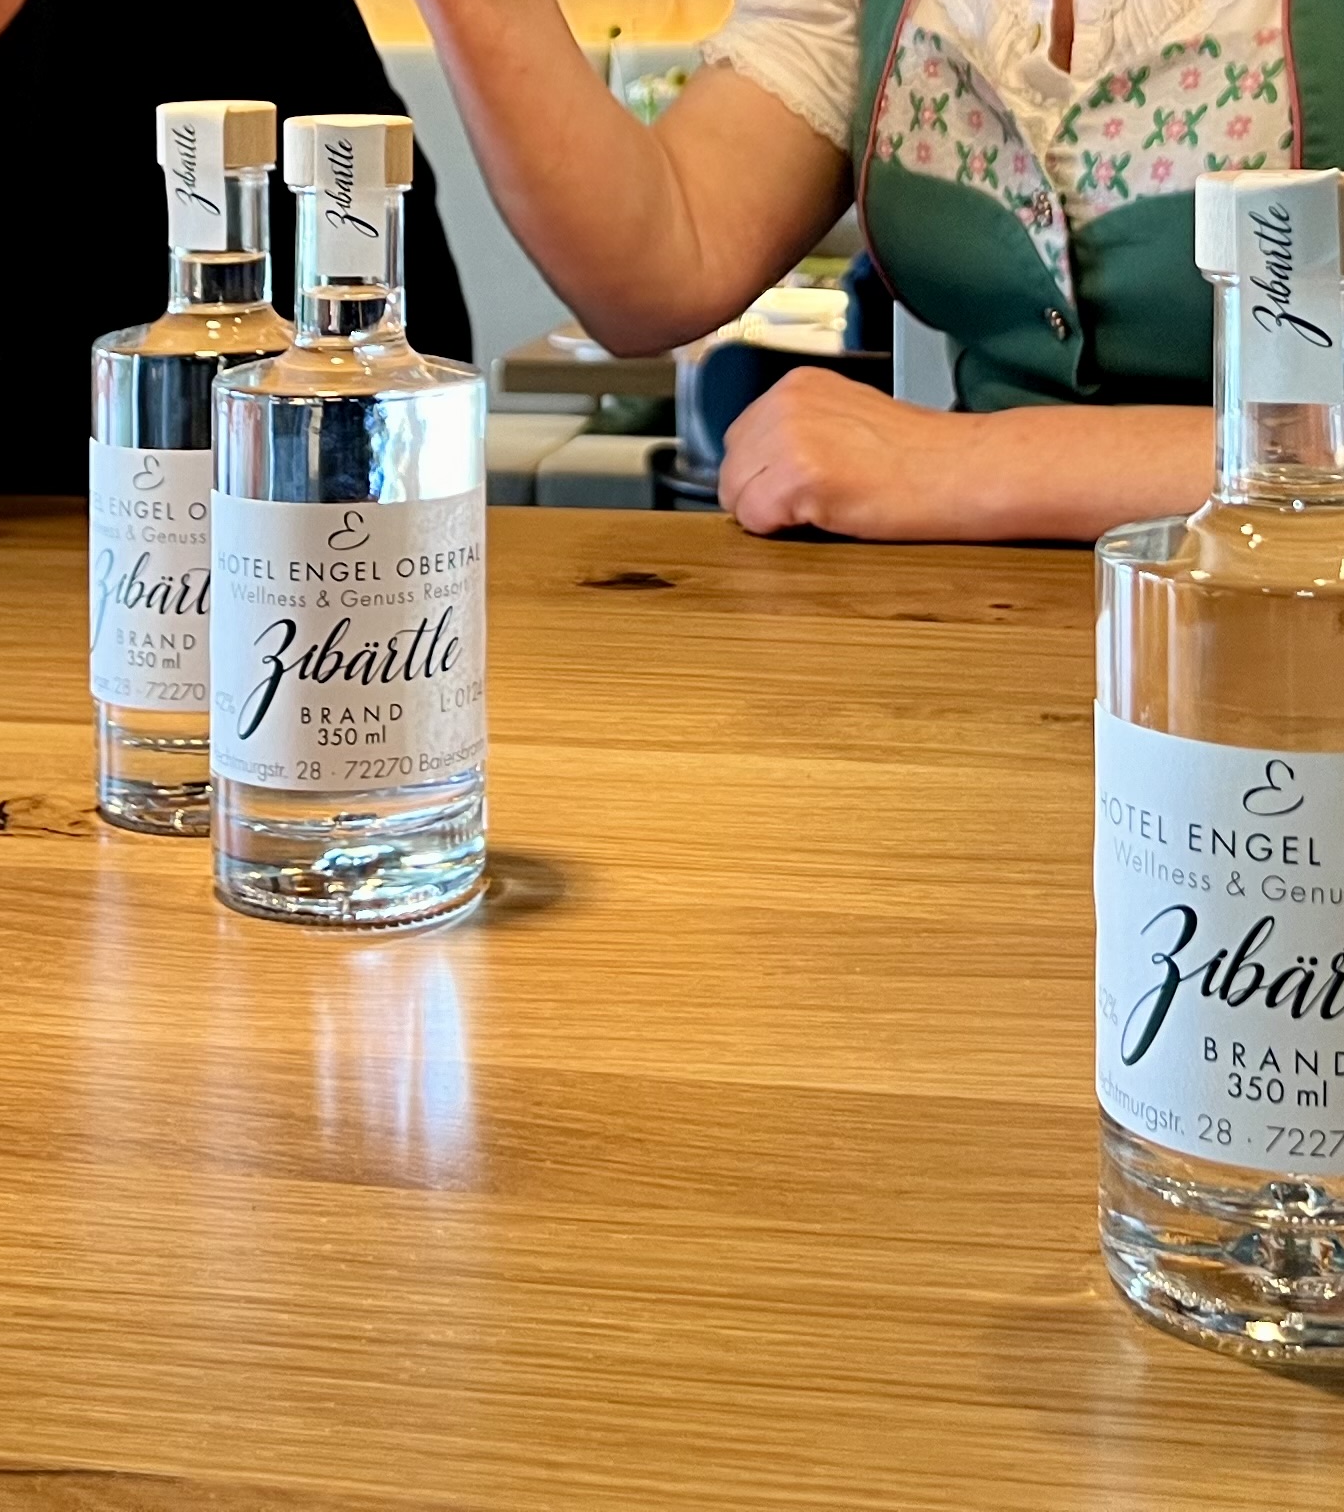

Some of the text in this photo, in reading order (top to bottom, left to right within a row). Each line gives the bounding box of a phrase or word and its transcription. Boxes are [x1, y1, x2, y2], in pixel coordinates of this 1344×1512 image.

[109, 497, 175, 521] ENGEL
[142, 526, 207, 544] Genuss
[218, 542, 480, 582] HOTEL ENGEL OBERTAL
[231, 581, 306, 607] Wellness
[316, 590, 330, 608] &
[341, 590, 414, 607] Genuss
[116, 628, 196, 650] BRAND
[127, 649, 180, 669] 350 ml
[237, 606, 463, 740] Zibärtle
[145, 681, 206, 700] 72270
[301, 703, 402, 724] BRAND
[318, 724, 386, 746] 350 ml
[297, 760, 321, 780] 28
[344, 756, 412, 779] 72270
[1188, 823, 1321, 866] ENGEL
[1114, 836, 1211, 891] Wellness
[1226, 871, 1245, 896] &
[1227, 1072, 1328, 1108] 350 ml
[1198, 1113, 1232, 1145] 28
